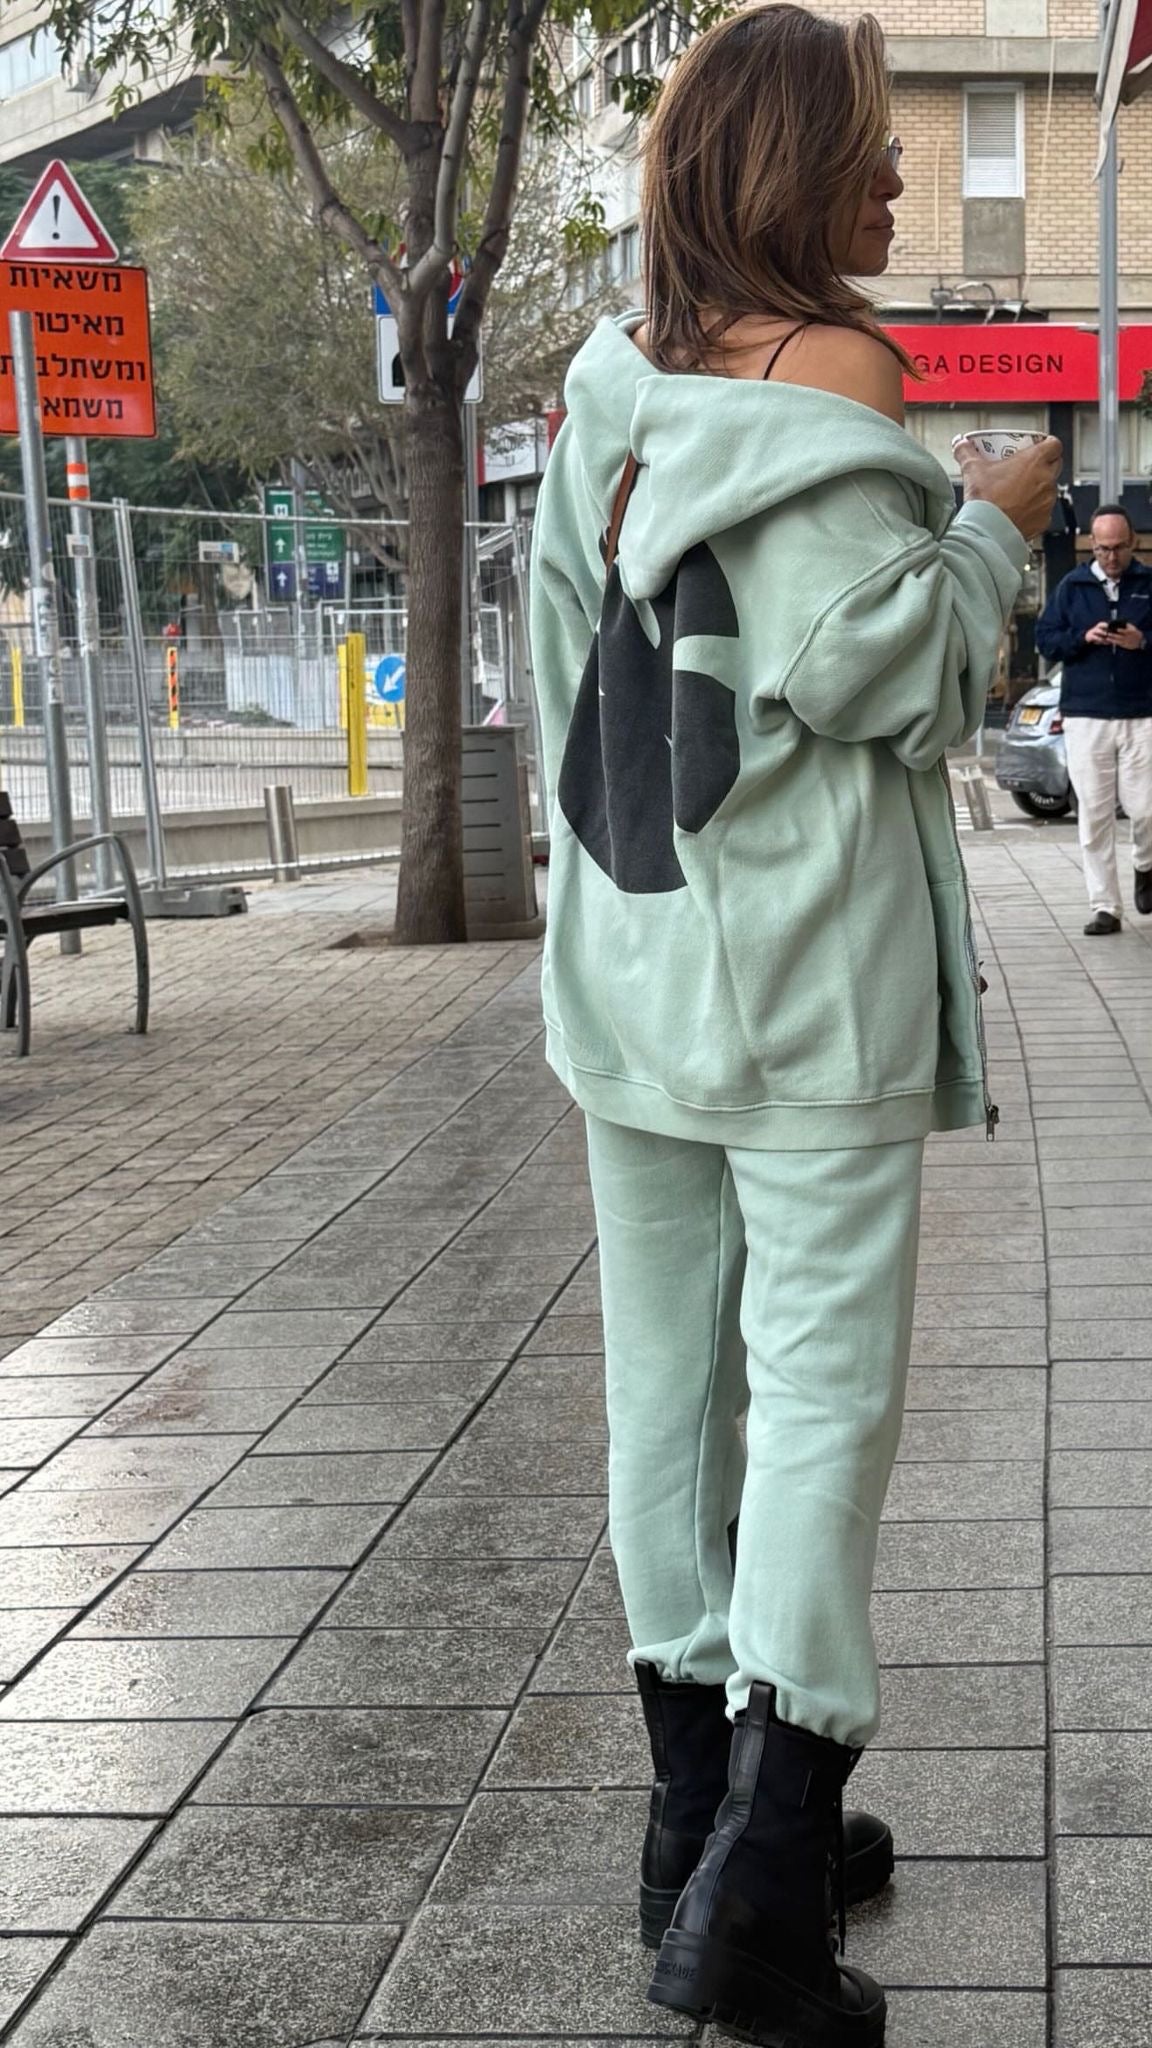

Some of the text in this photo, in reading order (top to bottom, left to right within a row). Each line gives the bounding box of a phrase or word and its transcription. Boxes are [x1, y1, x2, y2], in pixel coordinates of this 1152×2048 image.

[9, 266, 122, 292] משאיות
[35, 311, 124, 336] מאיטו
[0, 353, 146, 381] ומשתלבת
[959, 354, 1064, 374] DESIGN
[43, 396, 124, 419] משמא
